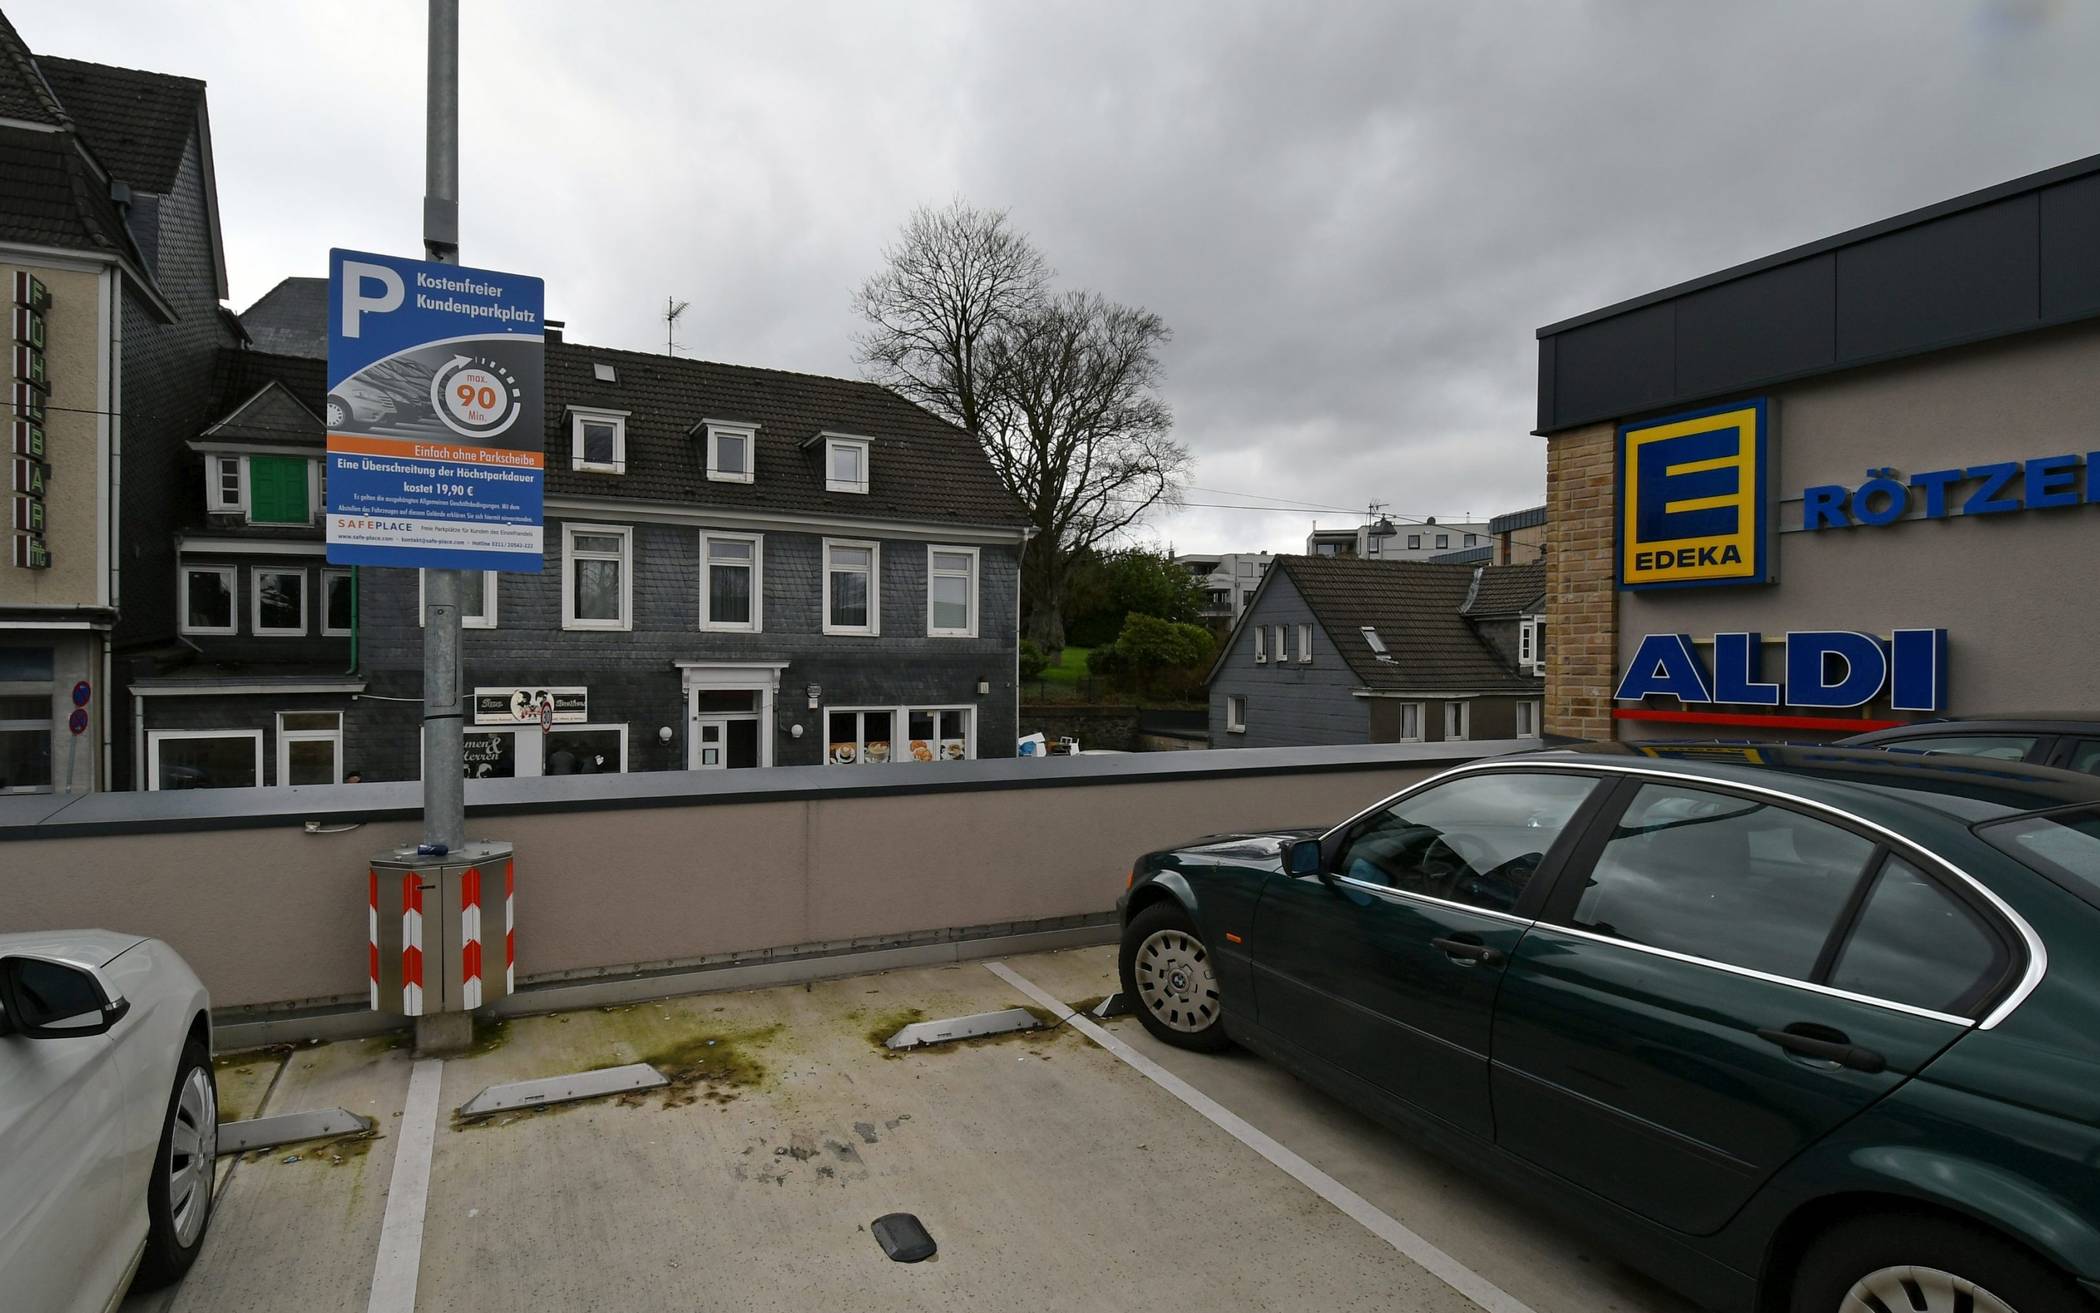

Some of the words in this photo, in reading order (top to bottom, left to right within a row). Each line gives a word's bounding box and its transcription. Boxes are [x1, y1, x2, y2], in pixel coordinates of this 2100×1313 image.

[417, 272, 502, 298] Kostenfreier
[342, 260, 405, 338] P
[417, 294, 535, 323] Kundenparkplatz
[466, 375, 488, 384] max.
[457, 384, 496, 410] 90
[468, 410, 487, 422] Min.
[415, 445, 450, 460] Einfach
[452, 448, 477, 461] ohne
[480, 450, 535, 466] Parkscheibe
[337, 458, 359, 470] Eine
[362, 457, 436, 478] Überschreitung
[438, 466, 454, 477] der
[456, 467, 535, 483] Höchstparkdauer
[403, 481, 433, 494] kostet
[436, 483, 464, 497] 19,90
[467, 486, 474, 497] €
[1634, 544, 1742, 572] EDEKA
[1613, 627, 1947, 712] ALDI
[464, 740, 489, 749] men
